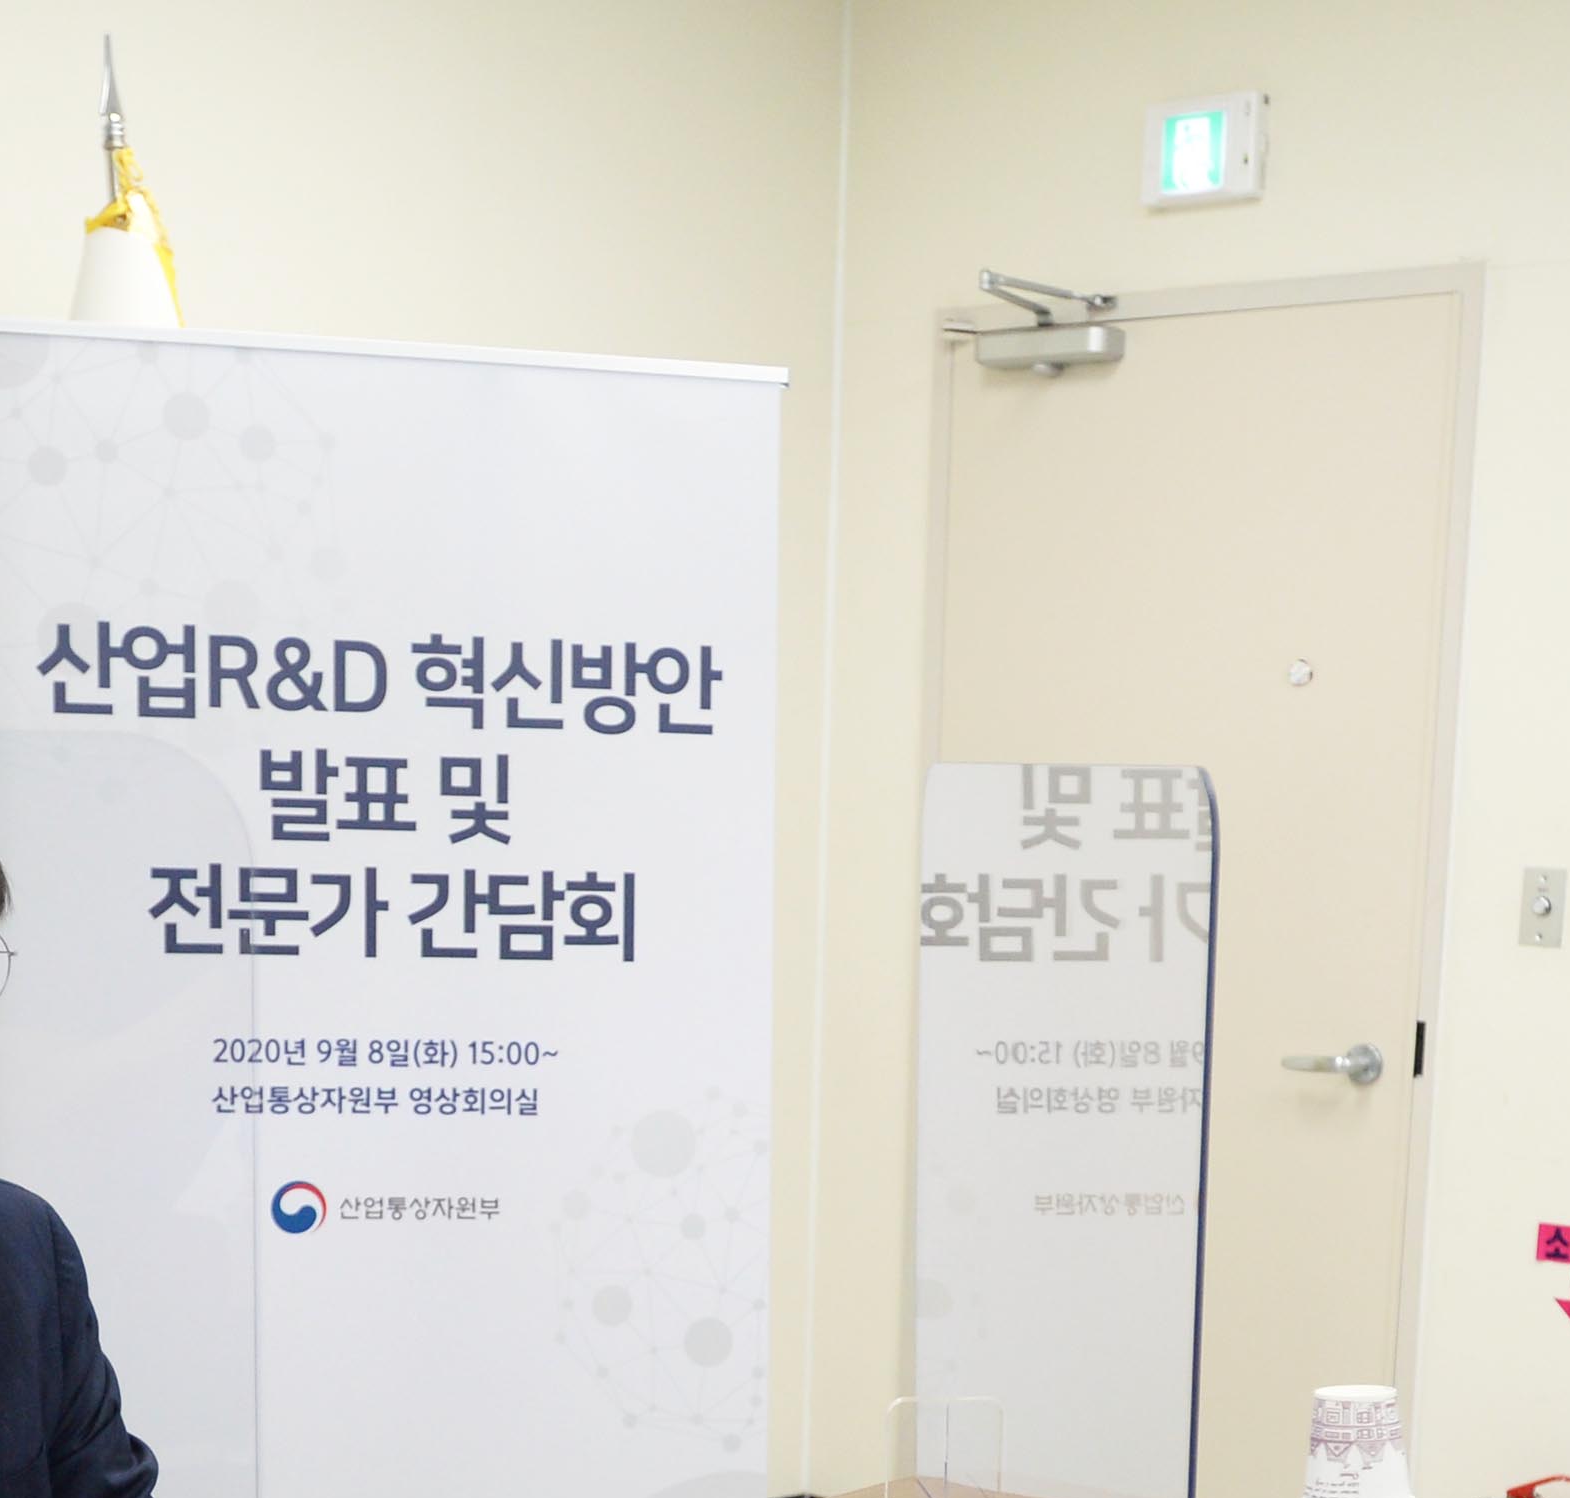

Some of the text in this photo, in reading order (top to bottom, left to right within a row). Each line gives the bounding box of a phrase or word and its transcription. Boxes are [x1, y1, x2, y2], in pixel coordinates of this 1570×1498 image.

[36, 620, 724, 736] 산업R&D 혁신방안
[259, 748, 513, 845] 발표 및
[149, 863, 637, 963] 전문가 간담회
[212, 1038, 559, 1069] 2020년 9월 8일(화) 15:00~
[211, 1086, 539, 1117] 산업통상자원부 영상회의실
[339, 1195, 502, 1223] 산업통상자원부
